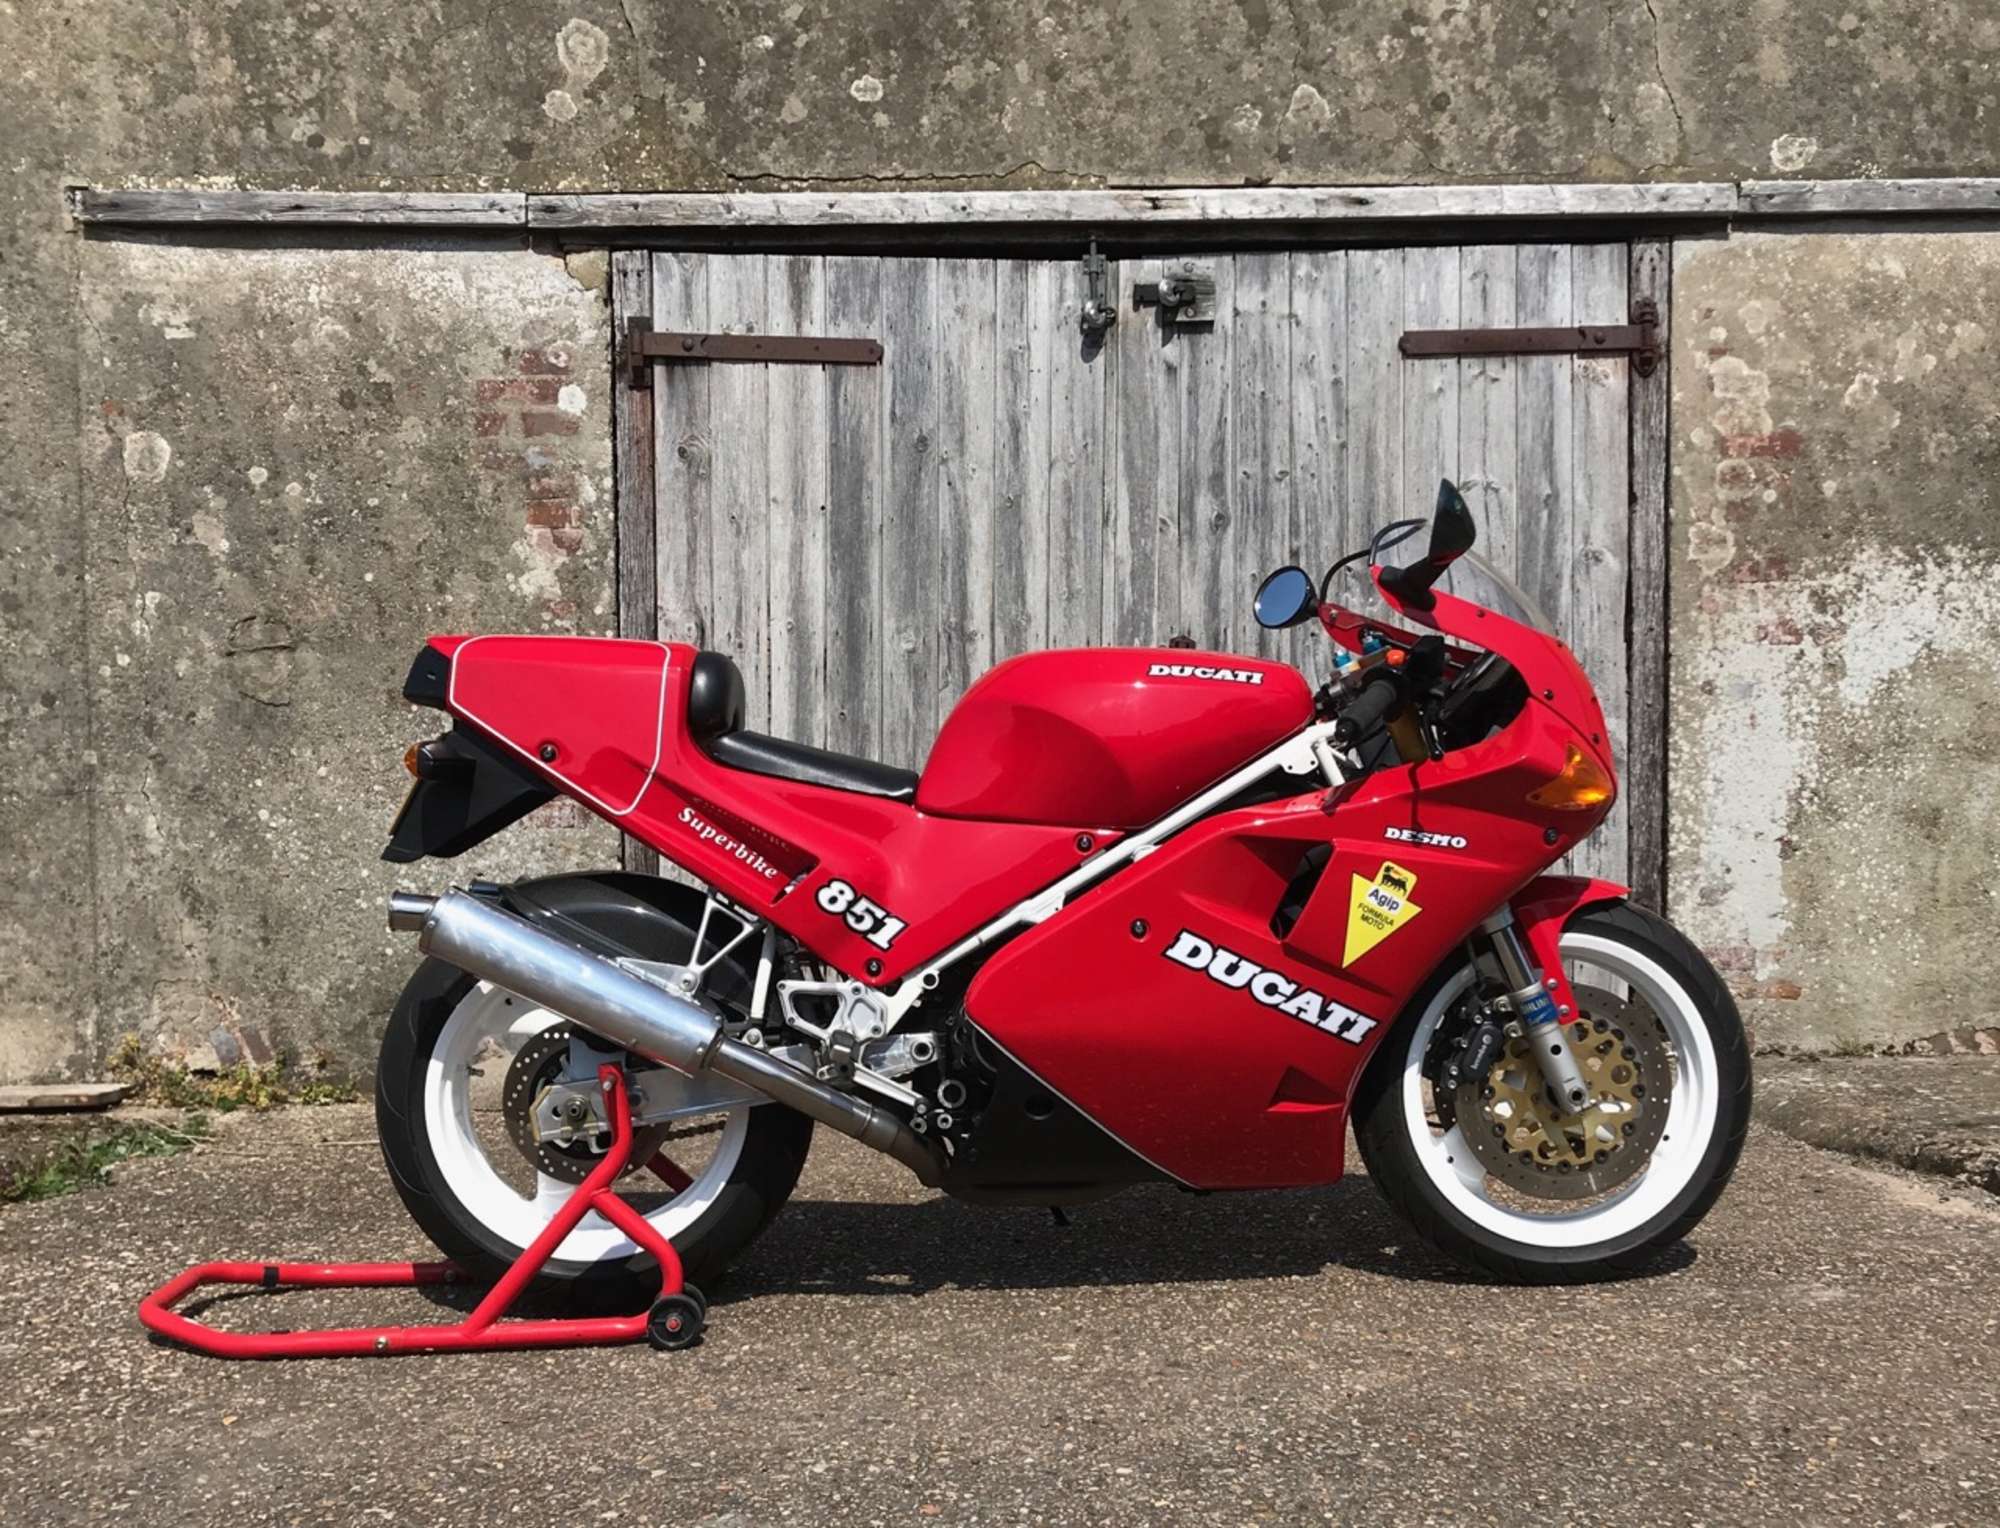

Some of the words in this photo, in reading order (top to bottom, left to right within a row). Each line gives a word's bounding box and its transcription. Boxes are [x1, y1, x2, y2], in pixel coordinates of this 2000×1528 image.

[1148, 664, 1264, 686] DUCATI
[678, 806, 779, 880] Superbike
[1384, 827, 1468, 849] DESMO
[1367, 887, 1400, 912] Agip
[817, 880, 907, 950] 851
[1357, 902, 1395, 927] FORMULA
[1360, 913, 1385, 931] MOTO
[1165, 930, 1378, 1044] DUCATI
